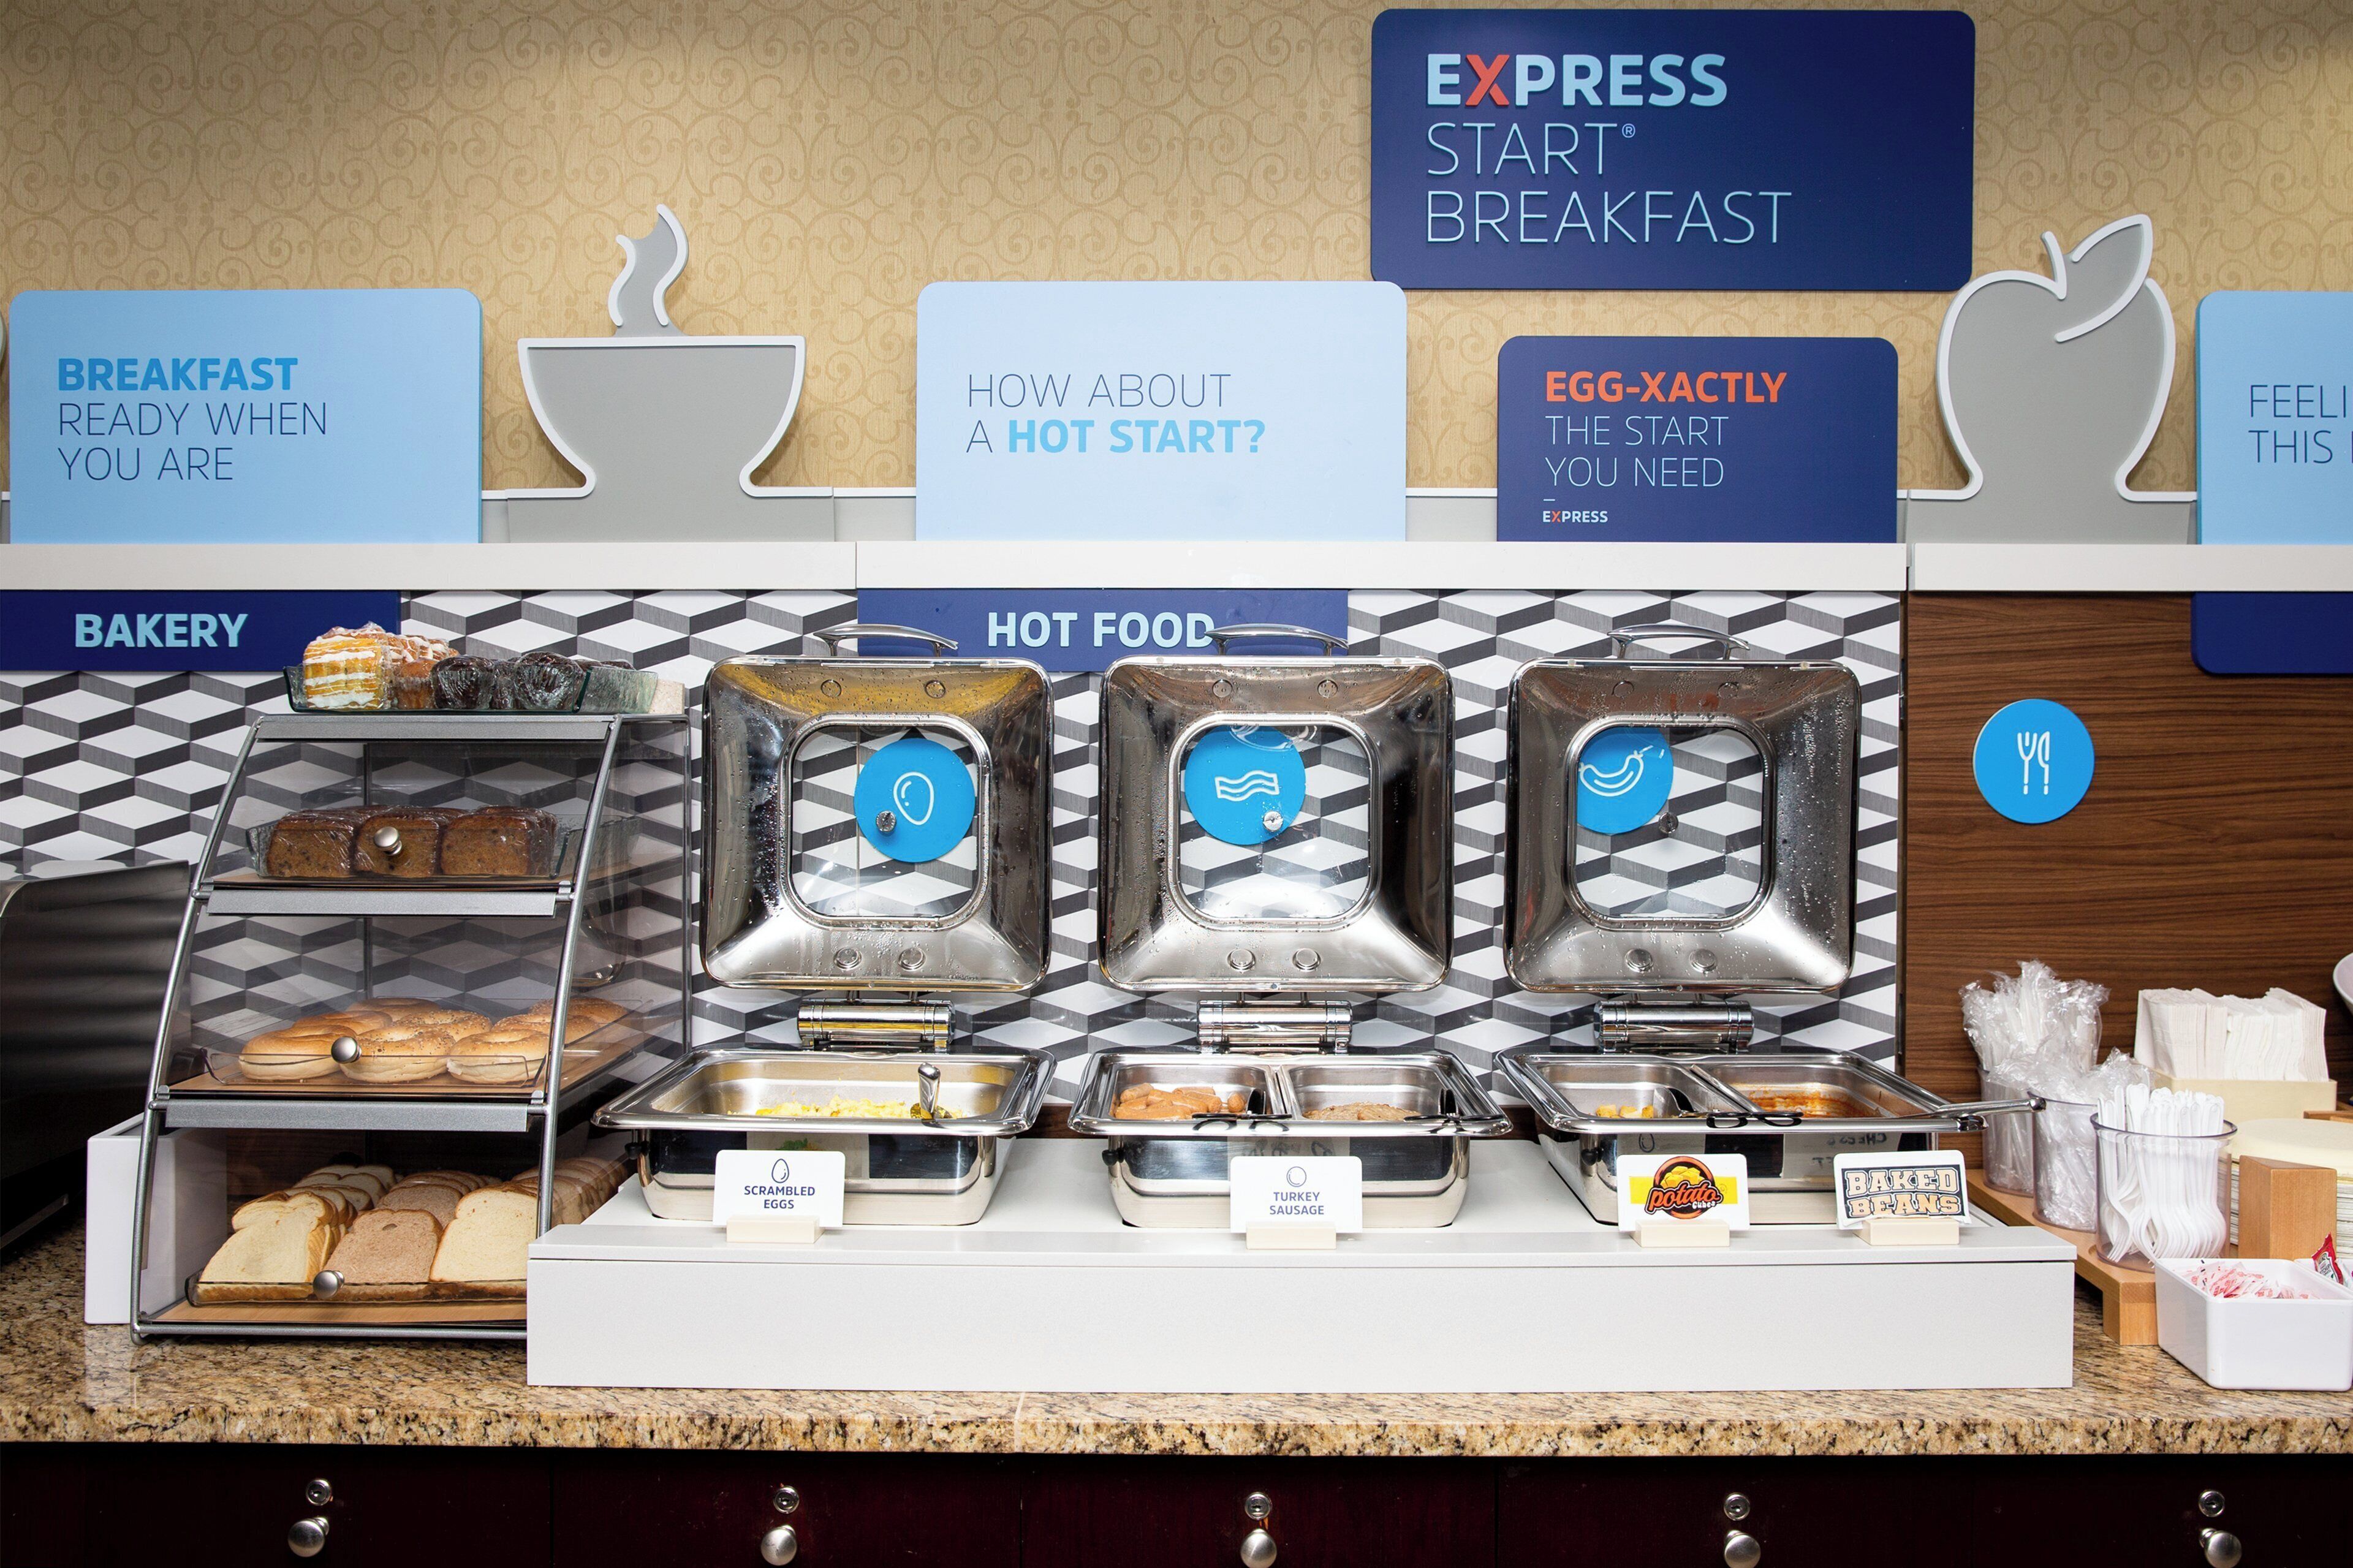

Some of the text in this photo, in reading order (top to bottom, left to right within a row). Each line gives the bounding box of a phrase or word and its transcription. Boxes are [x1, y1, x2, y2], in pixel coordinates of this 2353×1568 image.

[1427, 53, 1727, 107] EXPRESS
[1427, 191, 1792, 244] BREAKFAST
[58, 357, 298, 391] BREAKFAST
[1545, 371, 1787, 404] EGG-XACTLY
[968, 373, 1232, 408] HOW ABOUT
[59, 402, 327, 436] READY WHEN
[1545, 415, 1729, 446] THE START
[966, 419, 1266, 453] A HOT START?
[2248, 430, 2333, 464] THIS
[58, 447, 233, 481] YOU ARE
[1545, 456, 1724, 487] YOU NEED
[1542, 510, 1608, 523] EXPRESS
[75, 613, 249, 648] BAKERY
[988, 612, 1214, 648] HOT FOOD
[744, 1185, 816, 1196] SCRAMBLED
[1273, 1192, 1320, 1202] TURKEY
[1648, 1182, 1721, 1212] potato
[1845, 1167, 1960, 1198] BAKED
[763, 1199, 795, 1210] EGGS
[1269, 1205, 1325, 1215] SAUSAGE
[1692, 1200, 1716, 1210] Cubes
[1847, 1192, 1961, 1218] BEANS
